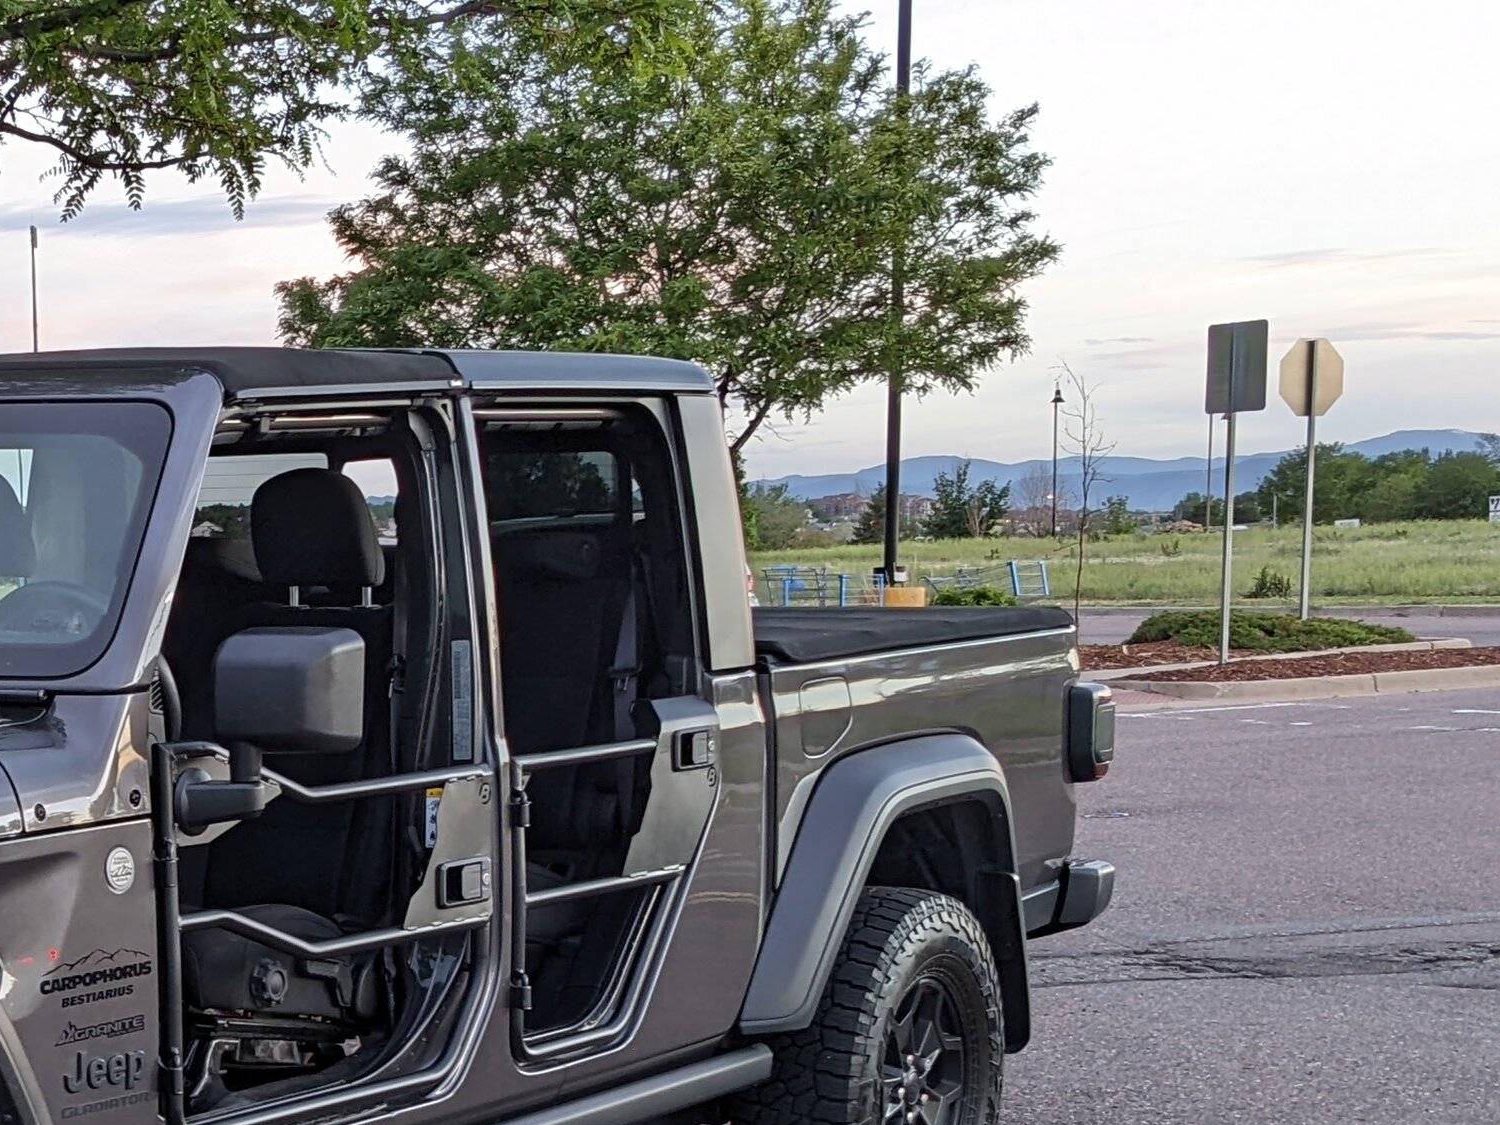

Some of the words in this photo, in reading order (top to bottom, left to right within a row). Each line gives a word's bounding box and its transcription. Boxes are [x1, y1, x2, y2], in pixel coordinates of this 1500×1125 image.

[40, 961, 152, 995] CARPOPHORUS
[61, 984, 134, 1009] BESTIARIUS
[74, 1014, 145, 1040] GRANITE
[63, 1050, 145, 1094] Jeep
[61, 1091, 153, 1119] GLADIATOR
